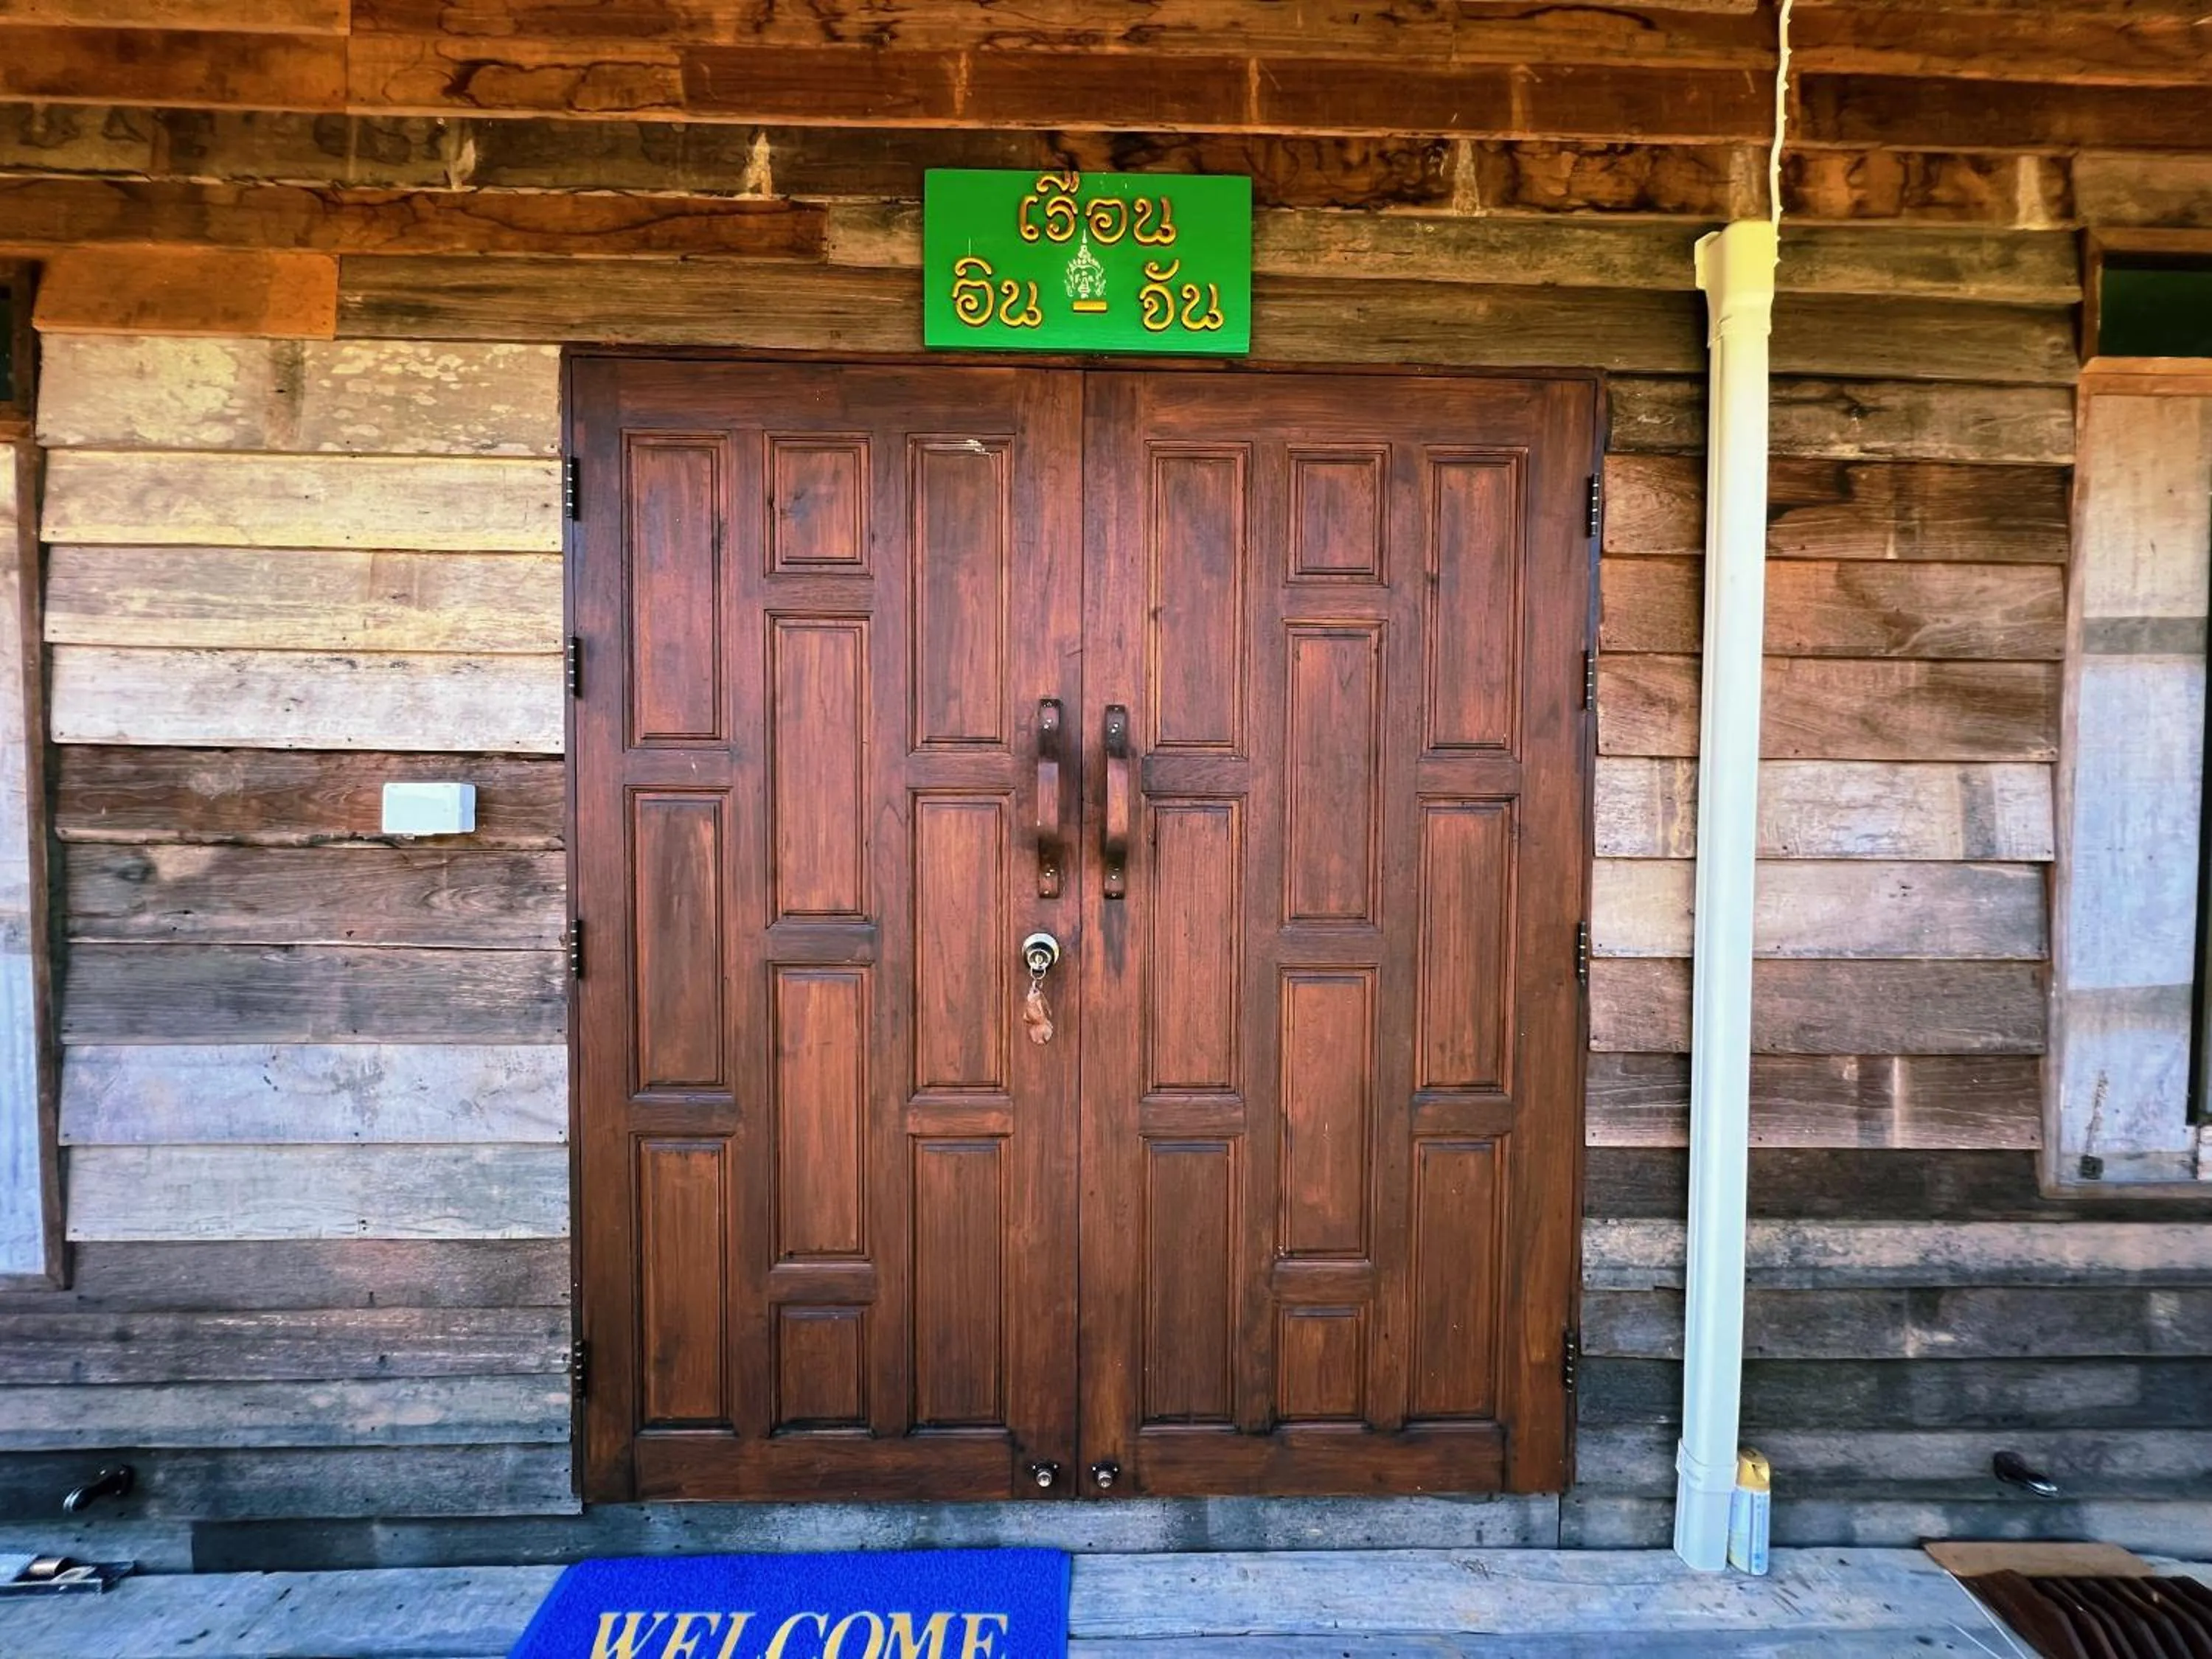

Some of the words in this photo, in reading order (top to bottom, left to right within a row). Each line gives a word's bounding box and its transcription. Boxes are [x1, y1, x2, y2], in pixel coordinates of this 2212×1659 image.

[1018, 170, 1178, 246] เรือน
[952, 256, 1043, 327] อิน
[1139, 259, 1225, 331] จัน
[590, 1611, 1008, 1659] WELCOME
